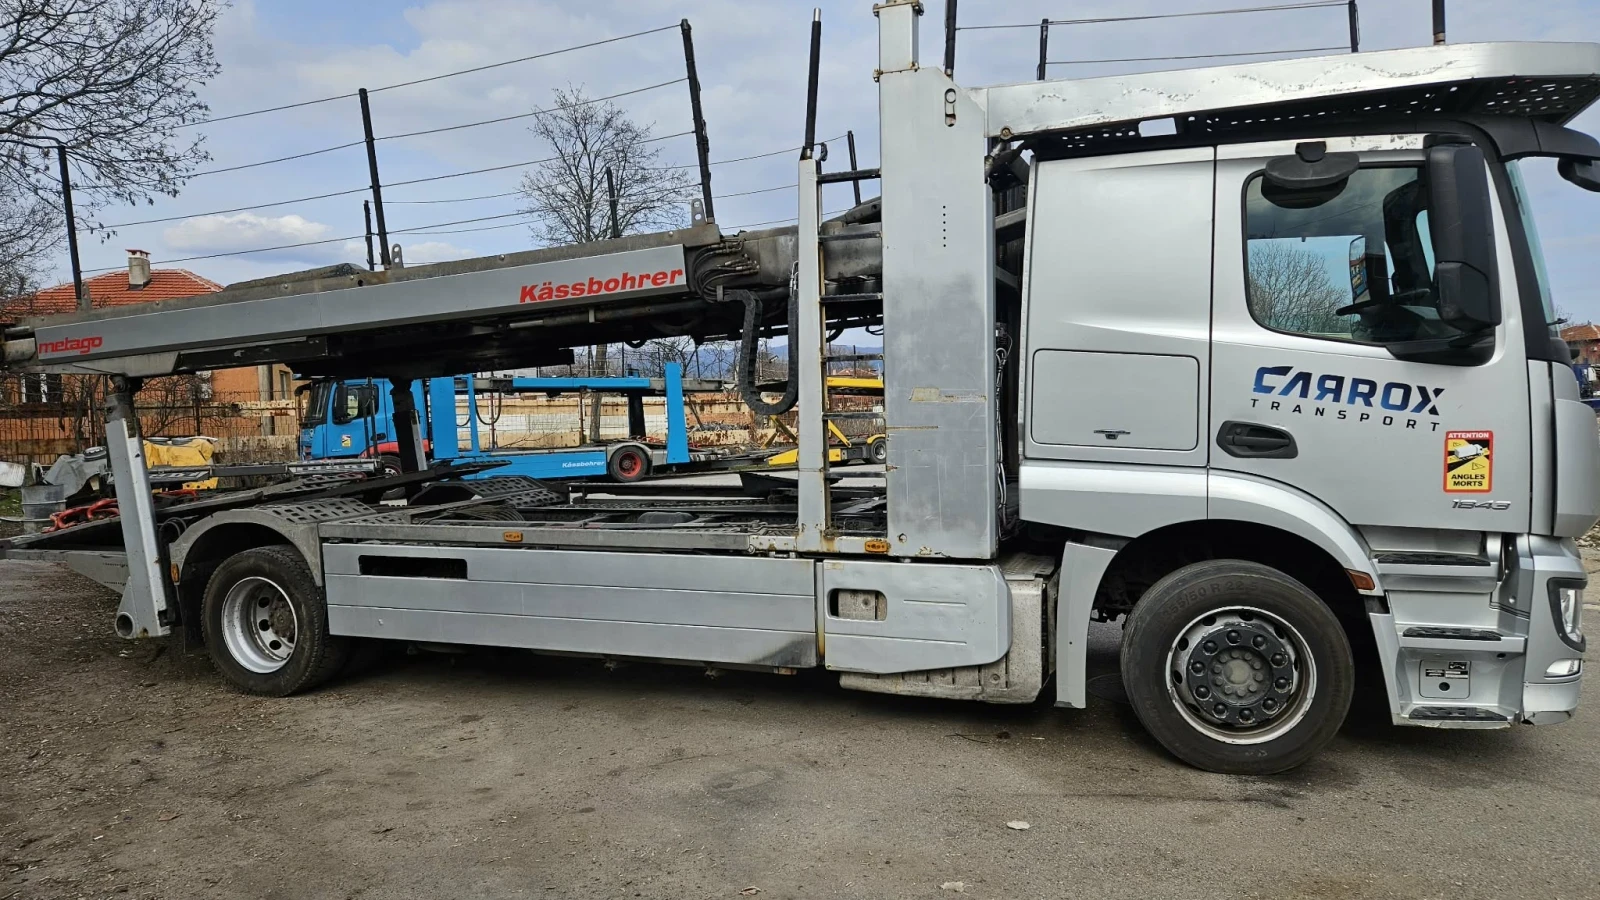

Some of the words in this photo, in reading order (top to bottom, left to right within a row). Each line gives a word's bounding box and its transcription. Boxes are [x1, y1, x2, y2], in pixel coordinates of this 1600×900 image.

[519, 268, 683, 304] Kässbohrer
[38, 336, 103, 355] metago
[1252, 365, 1445, 416] CARROX
[1250, 398, 1440, 432] TRANSPORT
[1452, 499, 1512, 510] 1843
